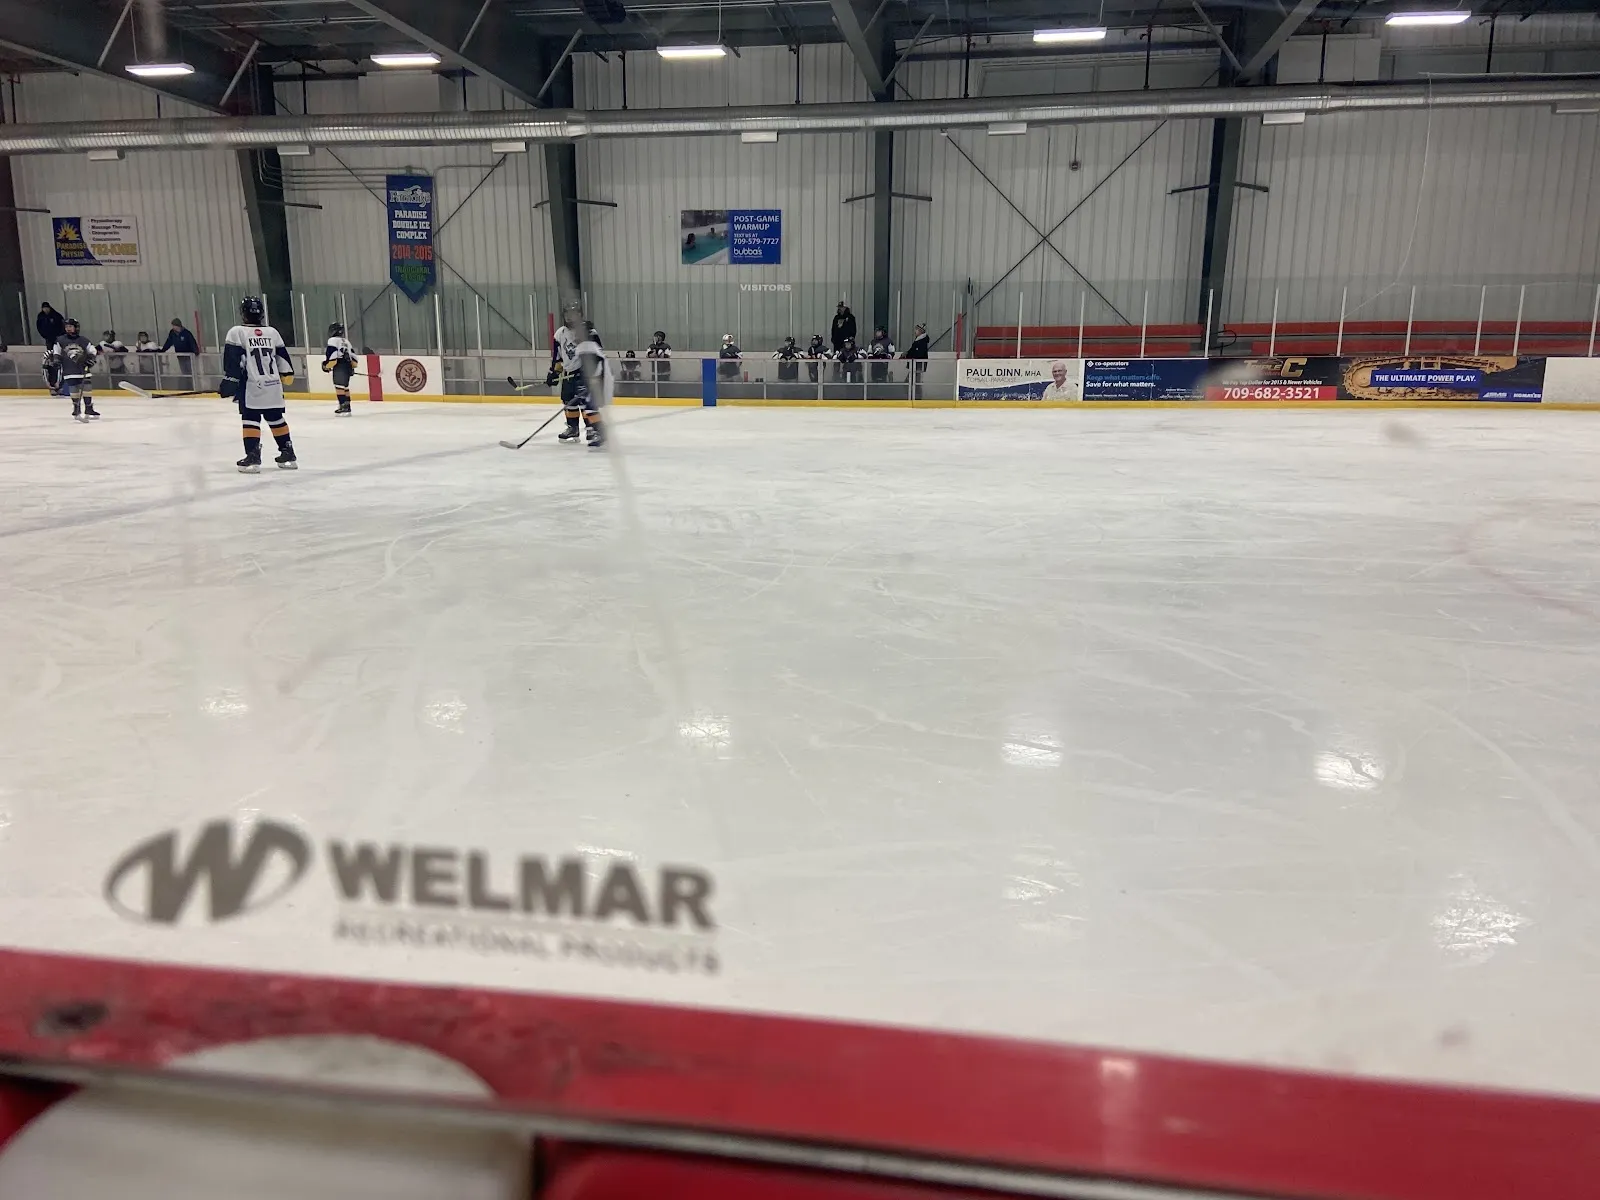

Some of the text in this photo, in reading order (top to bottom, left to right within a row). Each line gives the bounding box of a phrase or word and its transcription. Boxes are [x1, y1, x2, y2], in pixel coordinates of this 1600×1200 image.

[394, 209, 427, 219] PARADISE
[392, 220, 430, 230] DOUBLE ICE
[733, 223, 770, 231] WARMUP
[396, 230, 428, 240] COMPLEX
[392, 244, 432, 260] 2014-2015
[734, 246, 762, 256] bubba's
[740, 284, 792, 292] VISITORS
[248, 338, 272, 347] KNOTT
[250, 348, 274, 376] 17
[966, 368, 993, 377] PAUL
[1280, 357, 1308, 378] C
[1224, 387, 1320, 399] 709-682-3521
[327, 836, 719, 932] WELMAR
